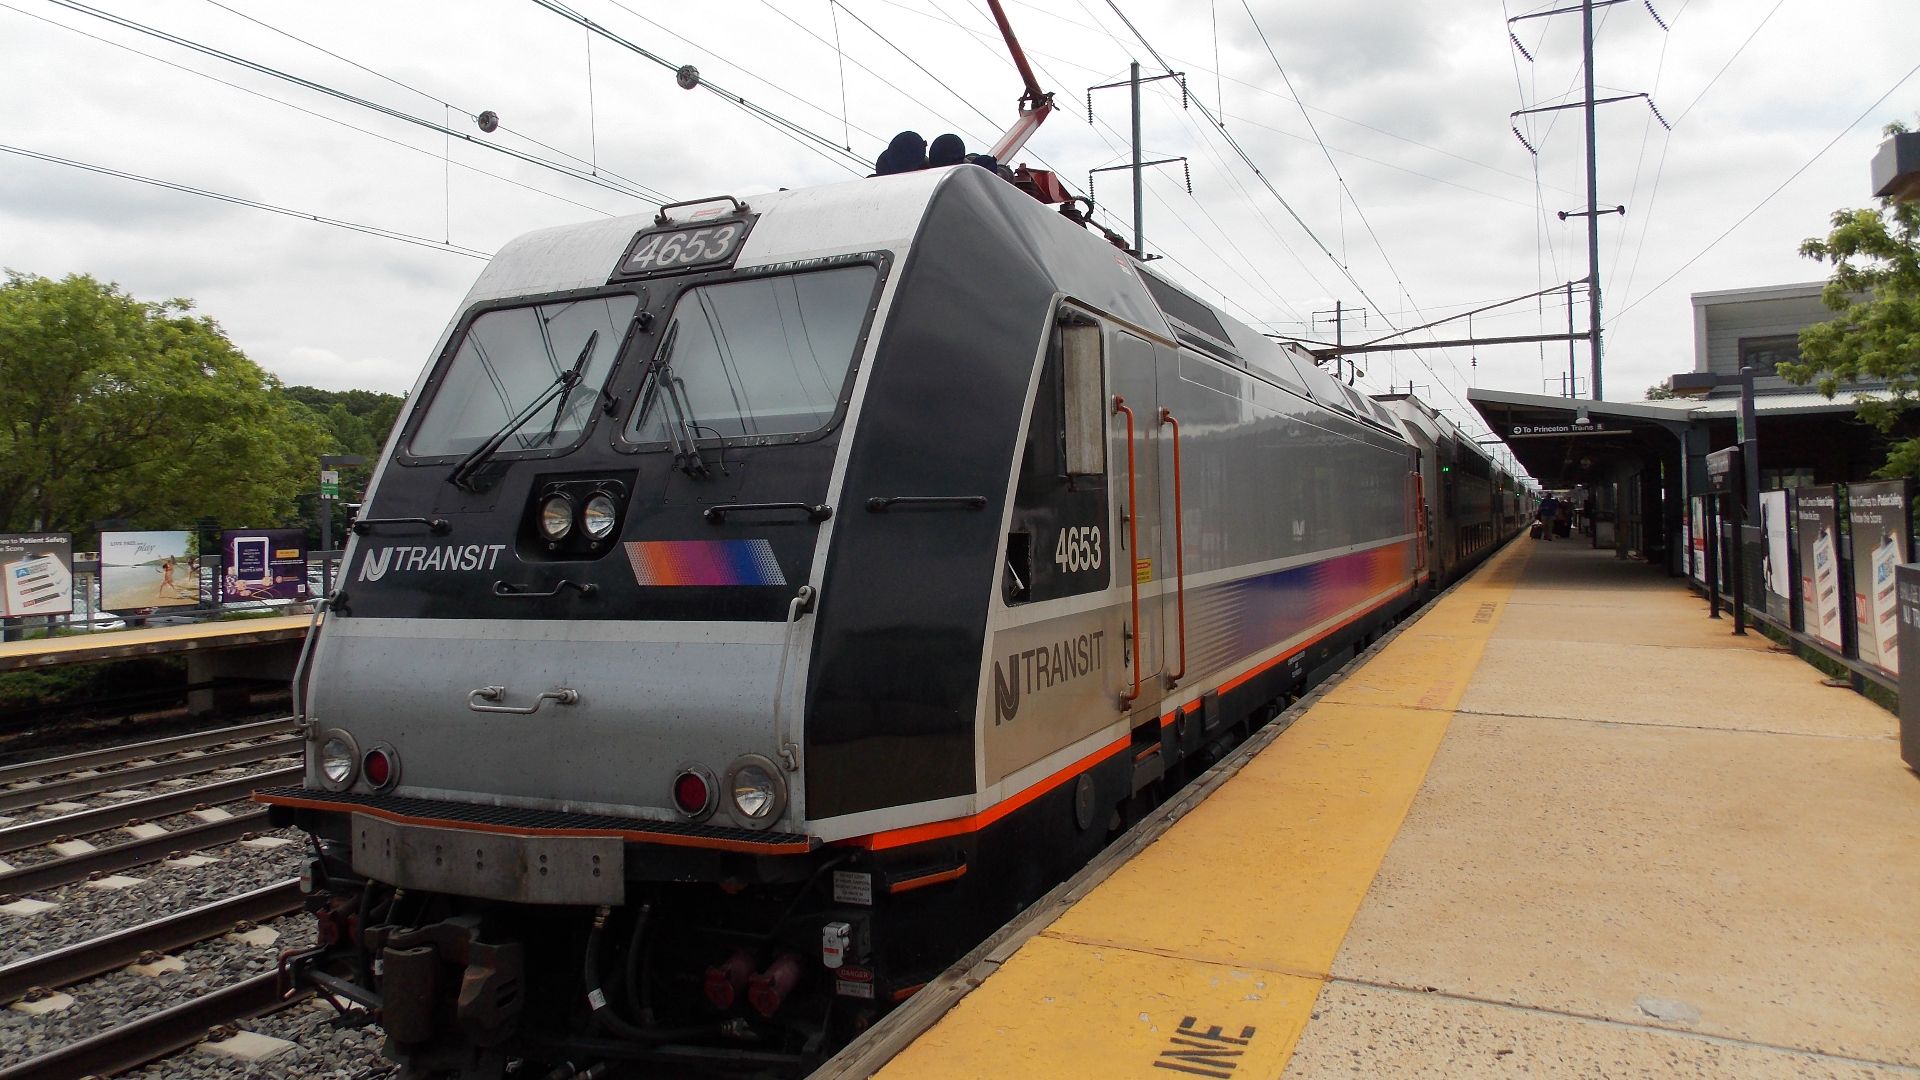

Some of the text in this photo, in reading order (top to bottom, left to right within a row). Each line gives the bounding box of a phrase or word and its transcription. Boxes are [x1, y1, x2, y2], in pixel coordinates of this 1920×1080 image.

[632, 226, 735, 269] 4653
[1533, 425, 1569, 433] Princeton
[134, 542, 157, 556] play
[394, 544, 507, 571] TRANSIT
[1055, 526, 1102, 573] 4653
[1022, 630, 1104, 694] TRANSIT
[841, 969, 868, 979] DANGER
